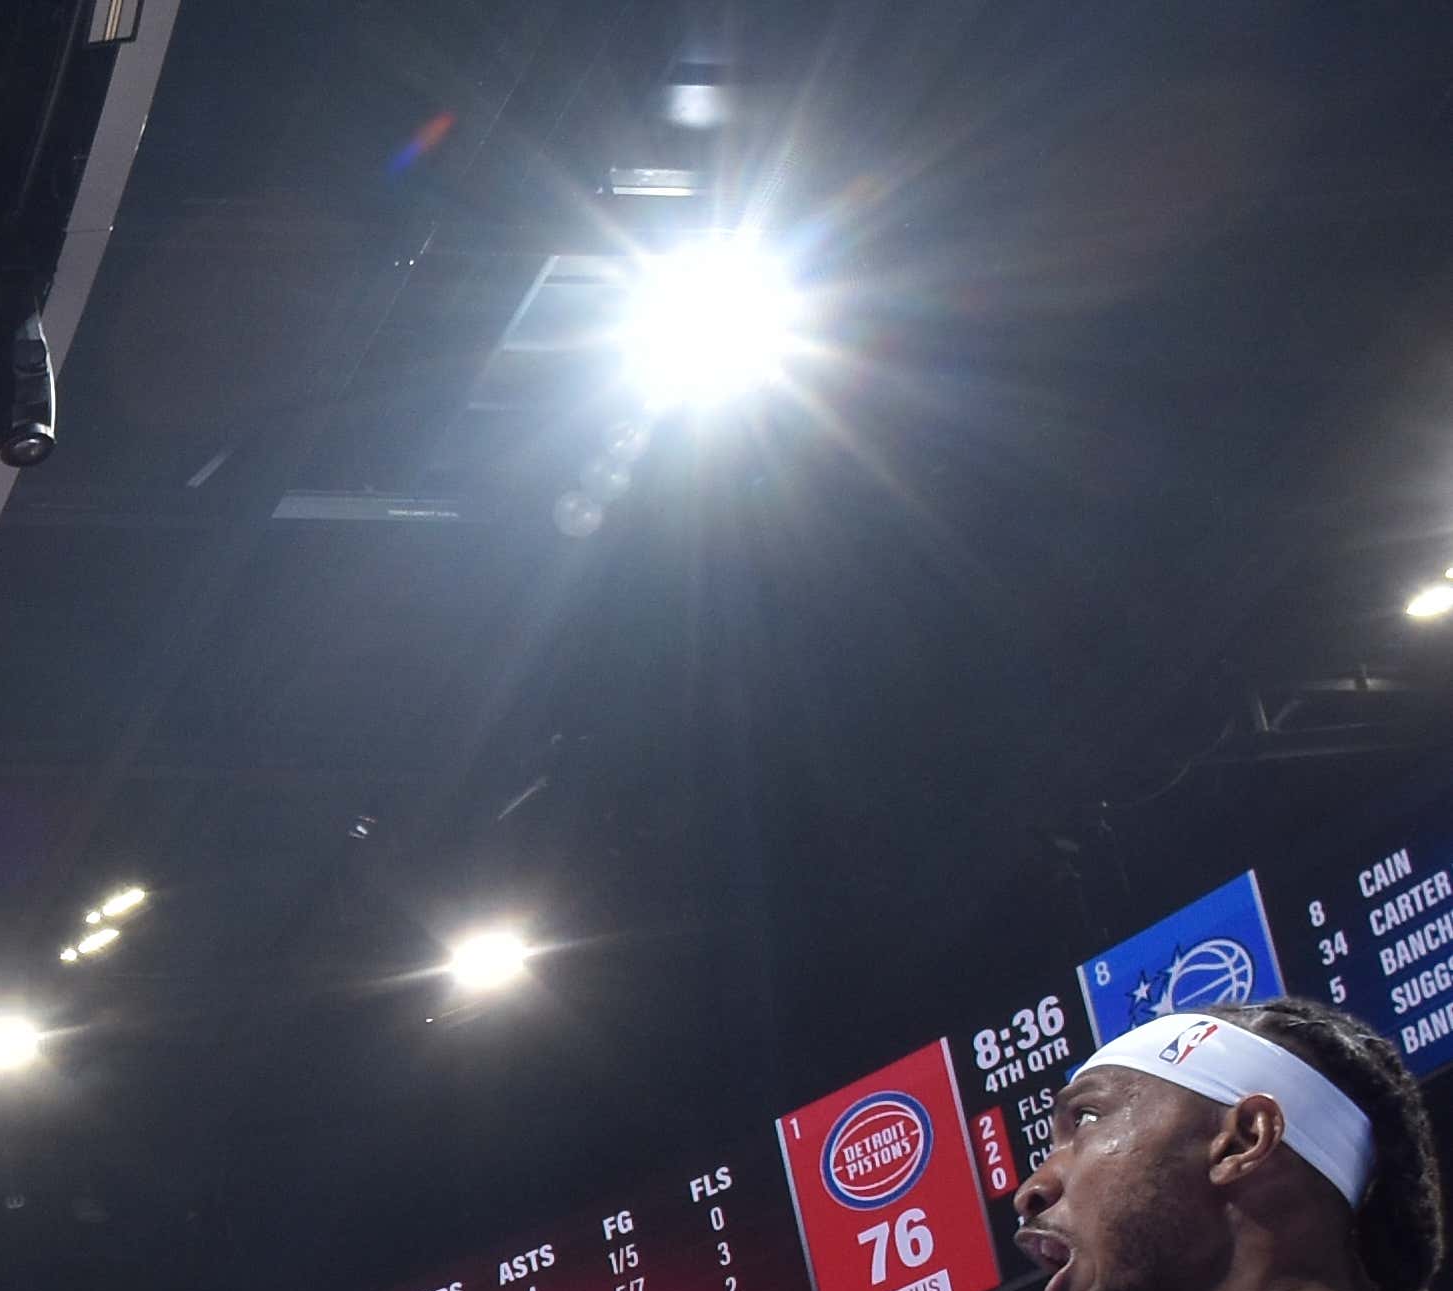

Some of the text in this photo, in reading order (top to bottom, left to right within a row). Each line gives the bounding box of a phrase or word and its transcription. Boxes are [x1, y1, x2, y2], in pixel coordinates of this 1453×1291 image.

[1358, 849, 1413, 899] CAIN
[1368, 870, 1452, 938] CARTER
[971, 995, 1066, 1072] 8:36
[984, 1038, 1070, 1095] 4TH QTR
[842, 1121, 907, 1162] DETROIT
[844, 1140, 912, 1182] PISTONS
[497, 1244, 556, 1286] ASTS
[602, 1210, 634, 1241] FG
[689, 1166, 732, 1202] FLS
[857, 1208, 935, 1287] 76
